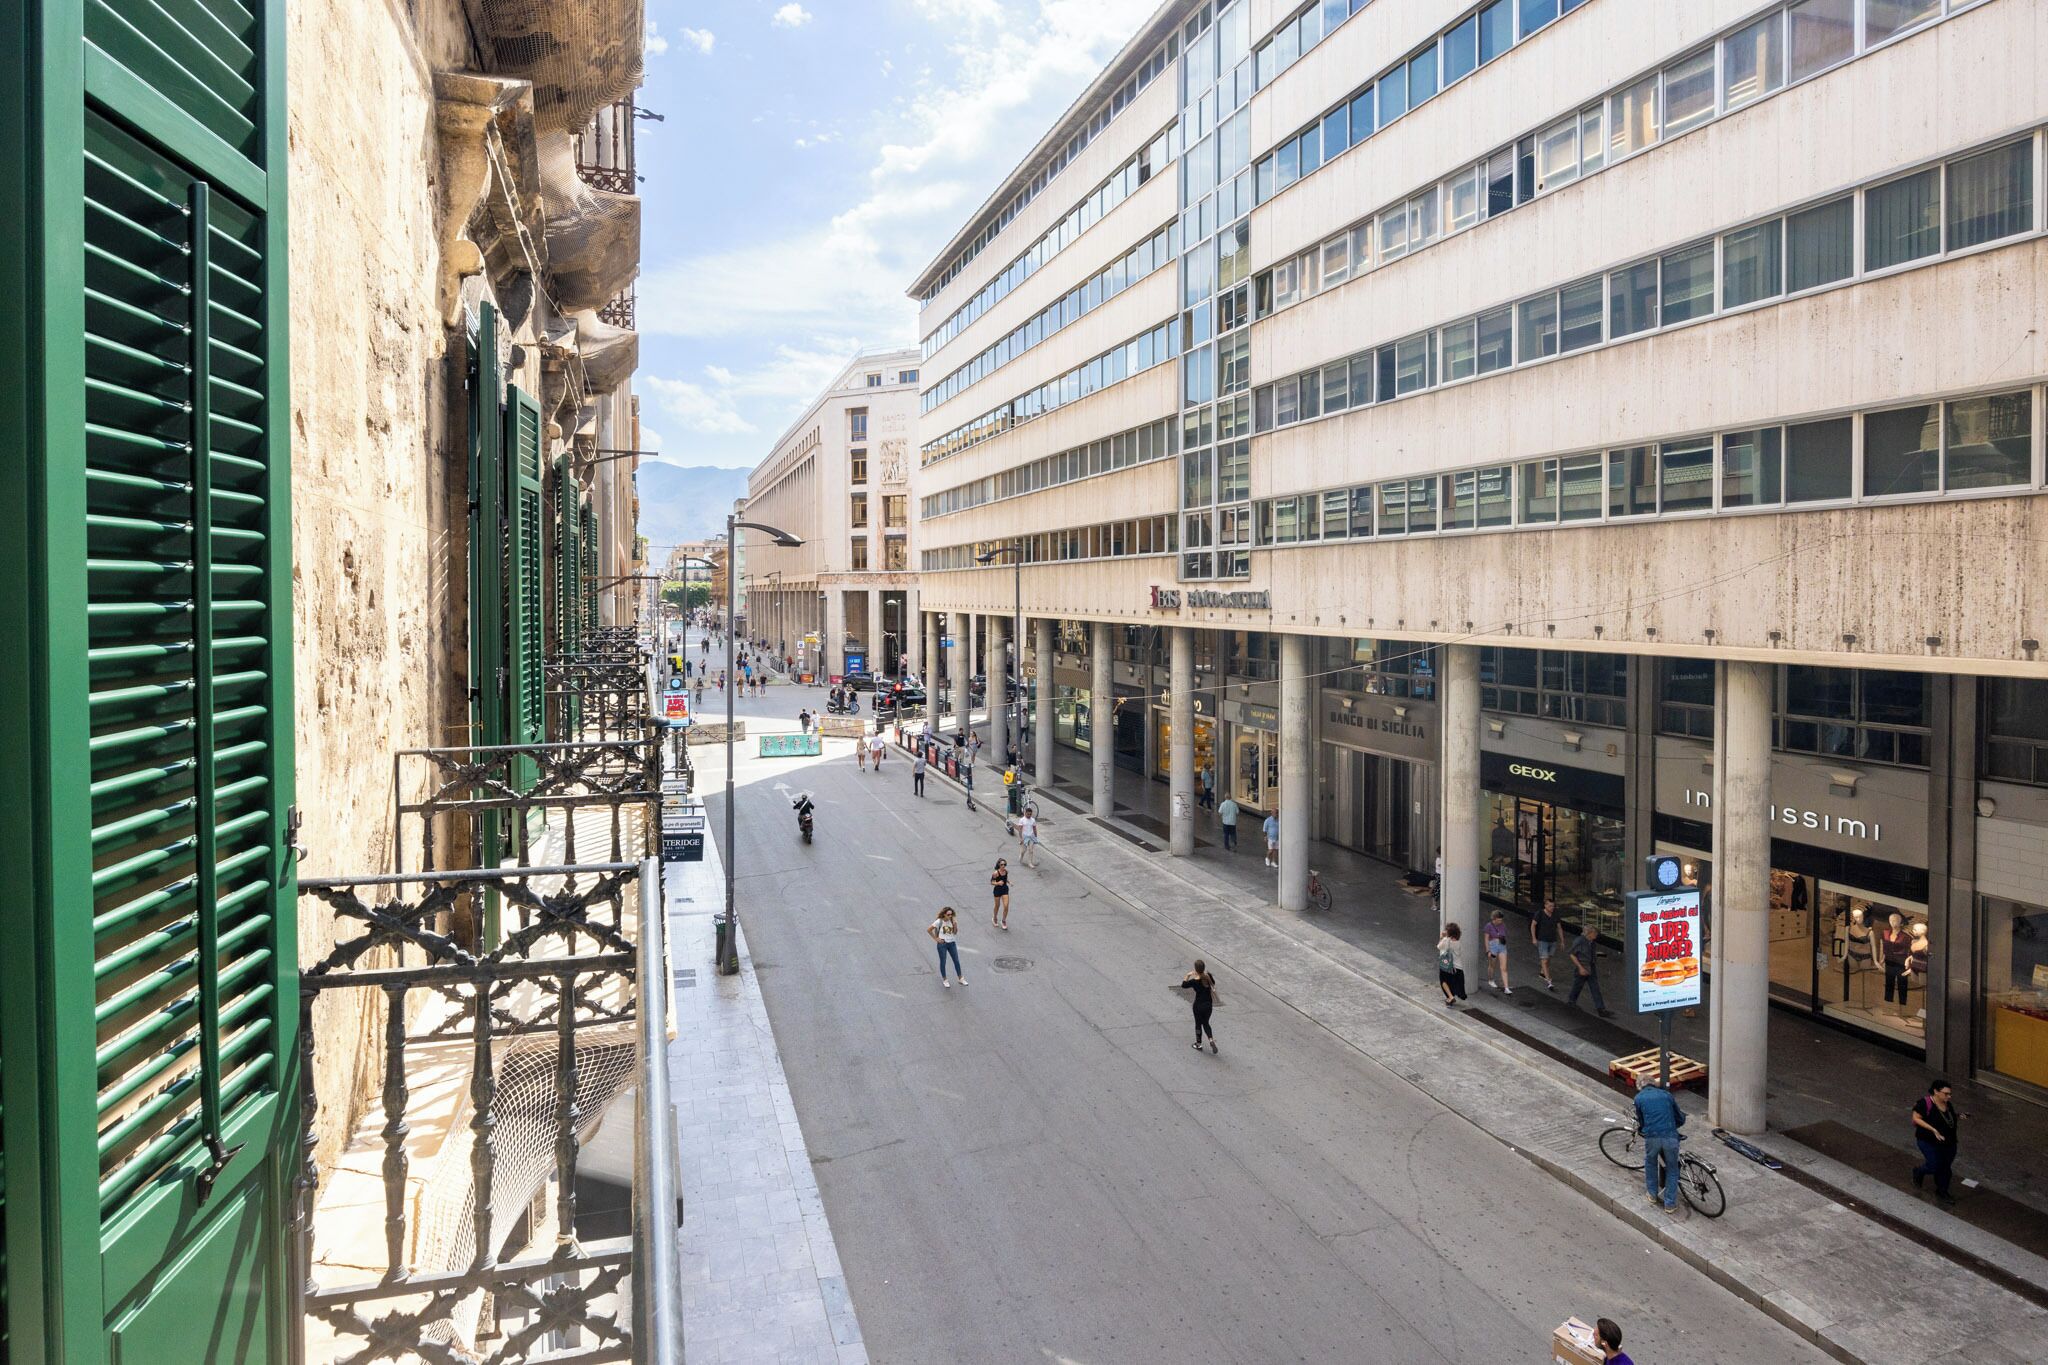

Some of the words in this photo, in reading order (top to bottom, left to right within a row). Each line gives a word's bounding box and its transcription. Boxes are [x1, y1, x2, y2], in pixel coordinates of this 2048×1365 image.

[1330, 711, 1363, 728] BANCO
[1367, 717, 1378, 730] DI
[1381, 720, 1425, 739] SICILIA
[1508, 763, 1557, 783] GEOX
[1686, 788, 1881, 842] inissimi
[1648, 920, 1690, 943] SLIDER
[1645, 939, 1693, 962] BURGER
